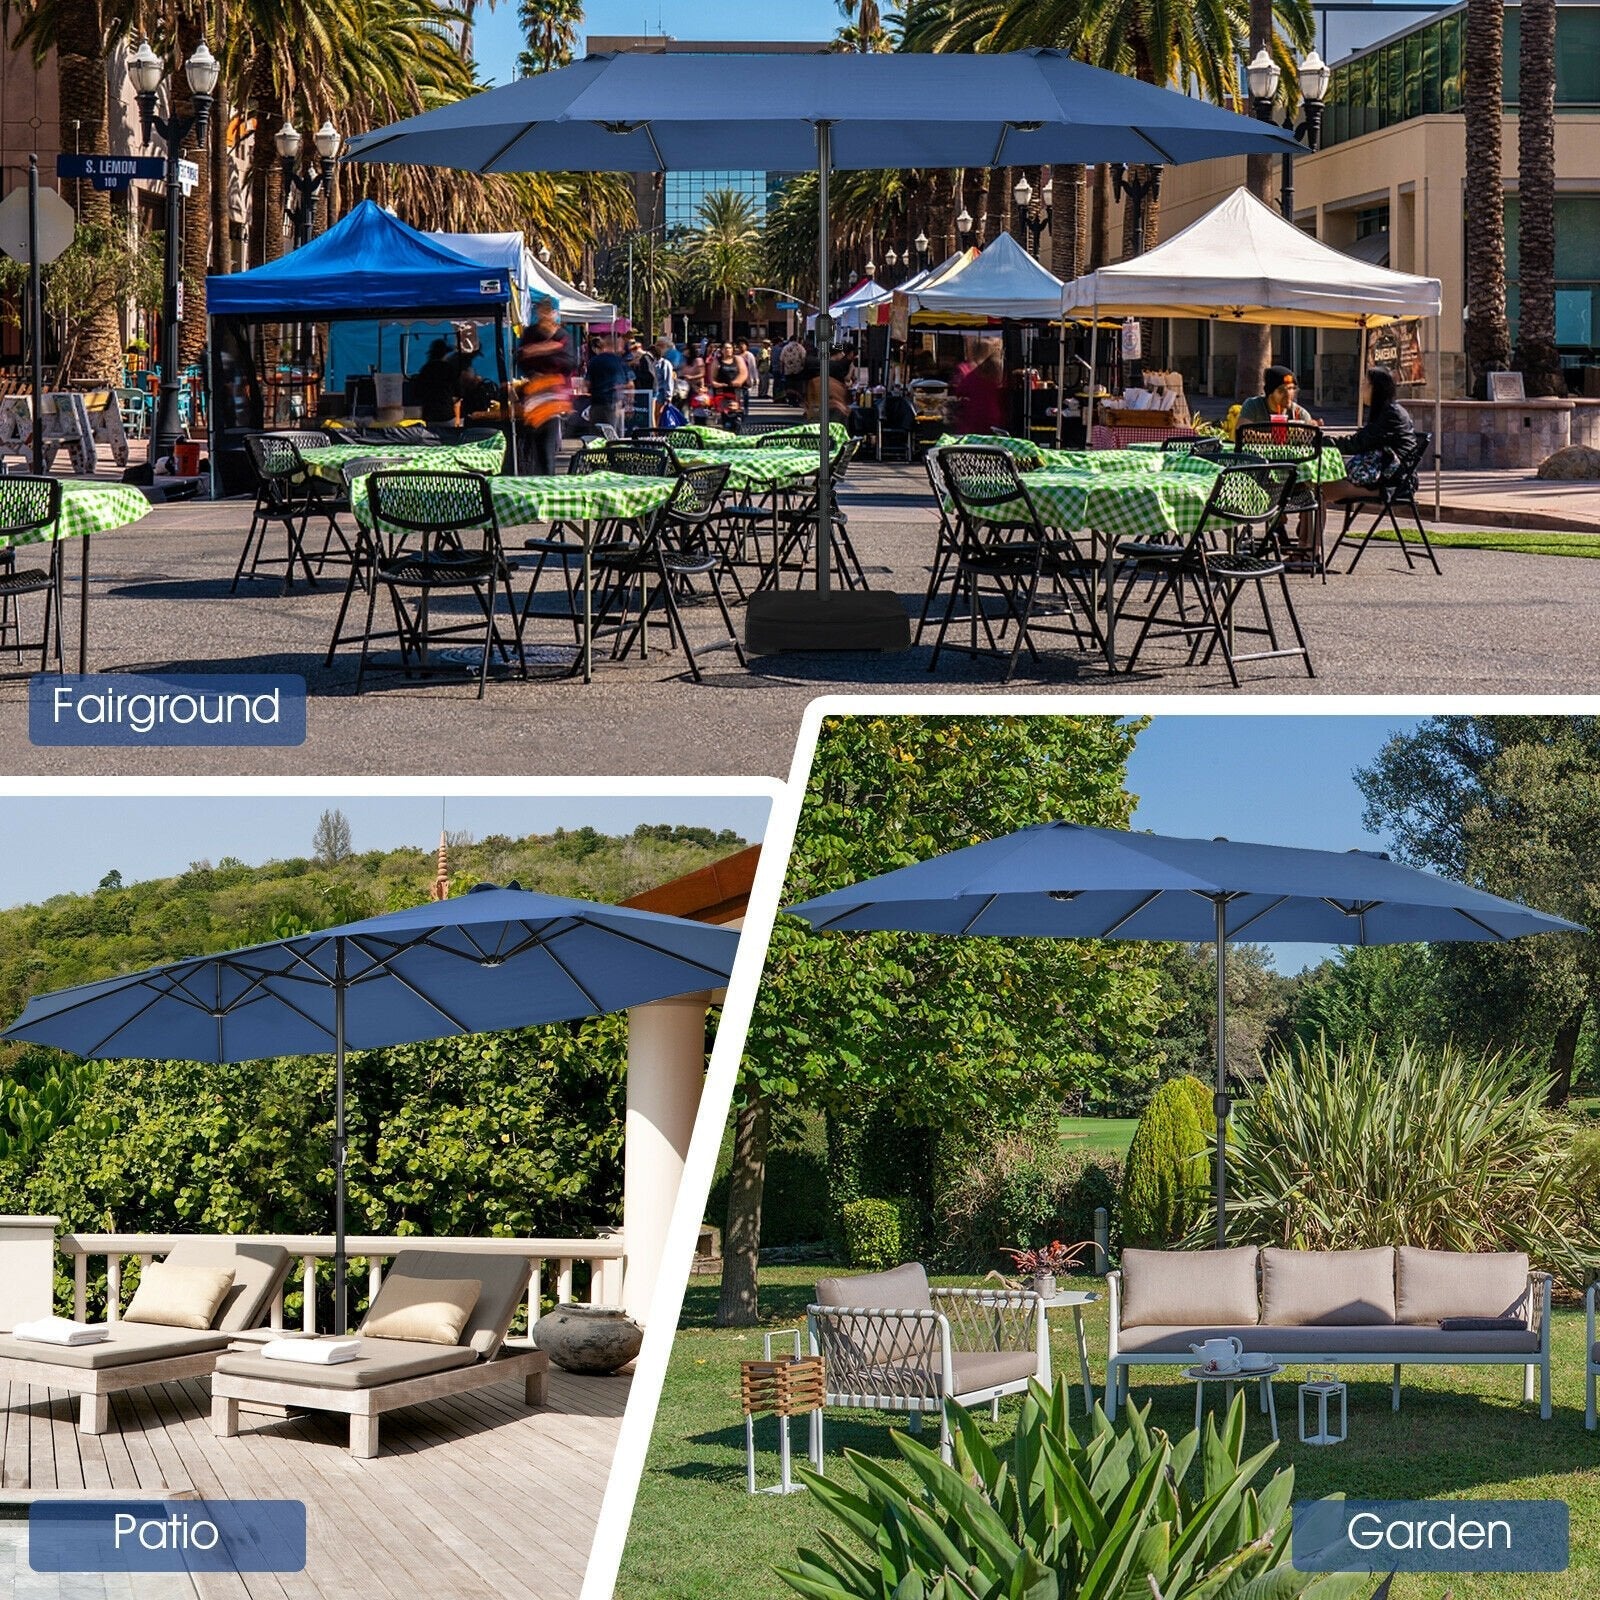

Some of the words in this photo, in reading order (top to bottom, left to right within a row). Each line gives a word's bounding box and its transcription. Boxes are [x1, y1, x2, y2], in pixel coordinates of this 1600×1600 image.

[86, 159, 96, 174] S.
[100, 160, 137, 174] LEMON
[104, 177, 117, 187] 100
